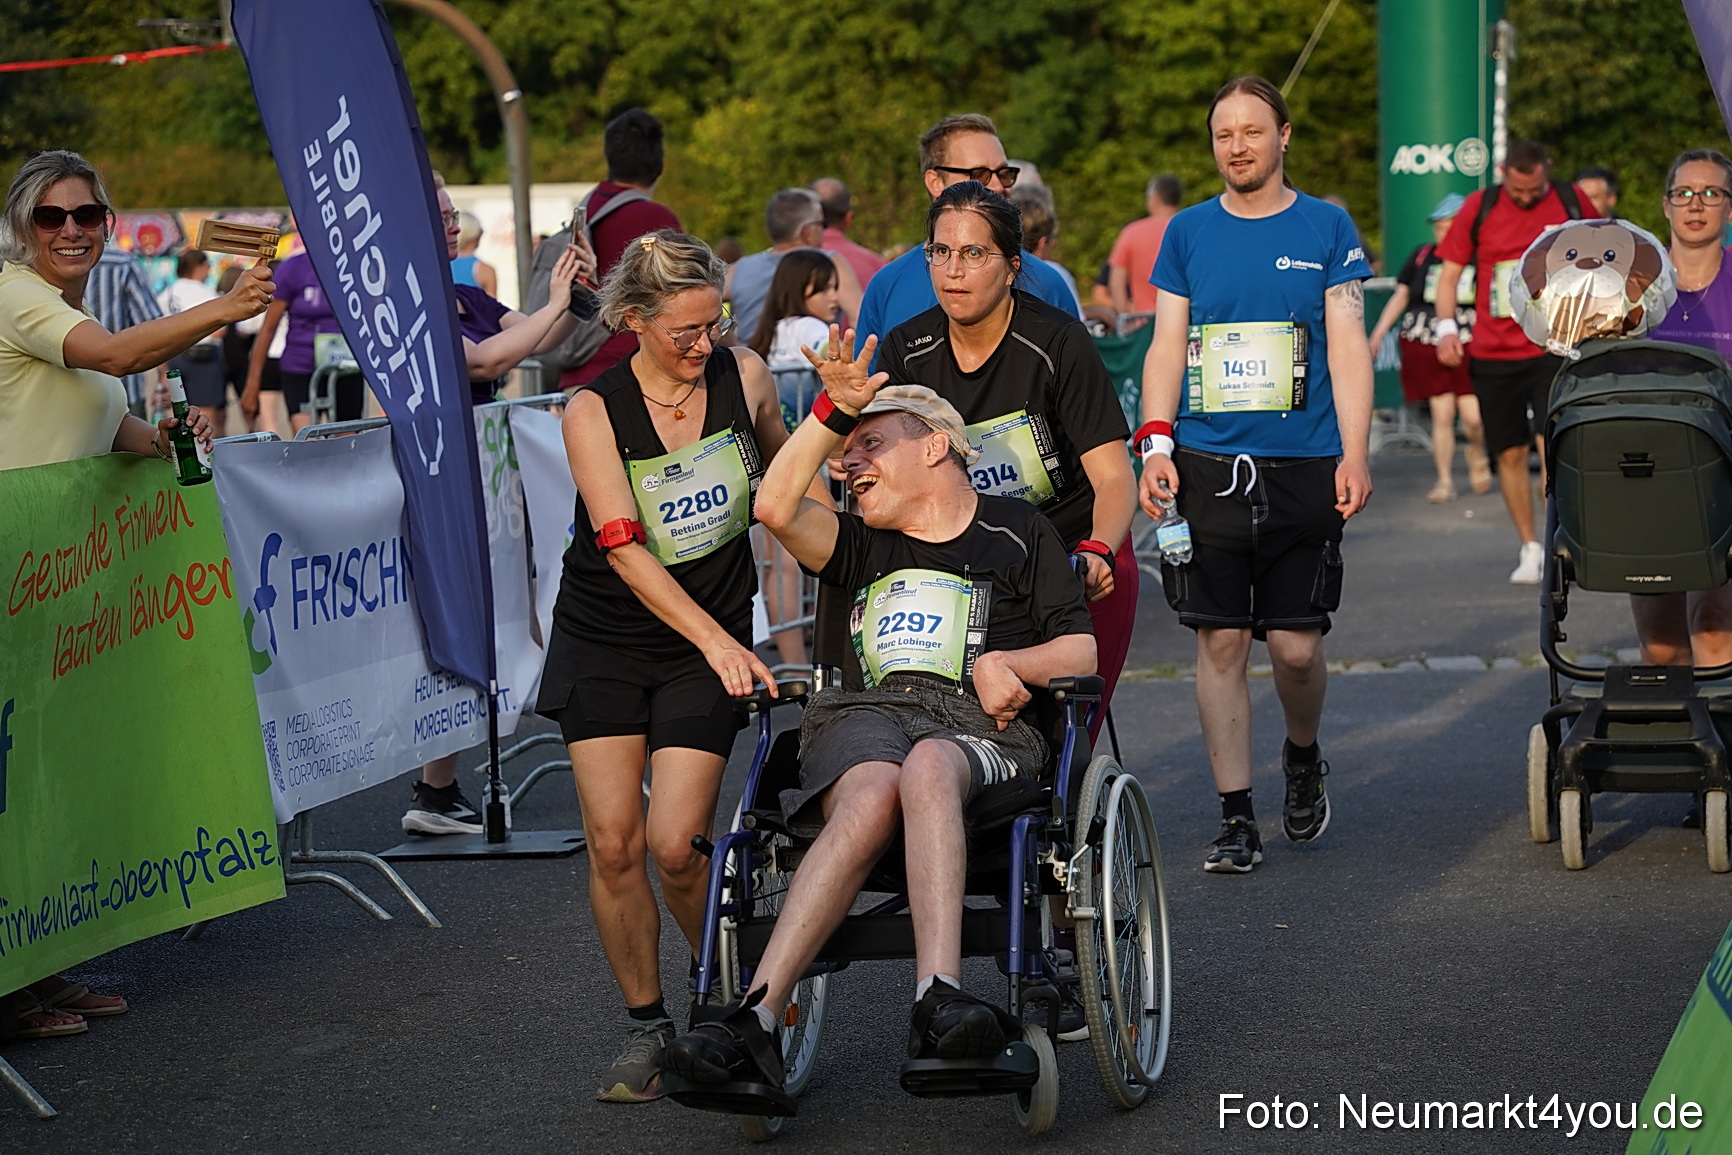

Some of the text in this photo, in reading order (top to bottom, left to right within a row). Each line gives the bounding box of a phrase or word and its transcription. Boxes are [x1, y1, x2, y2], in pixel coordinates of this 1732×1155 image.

[1390, 143, 1456, 175] AOK
[914, 335, 933, 346] JAKO
[1223, 359, 1267, 377] 1491
[1218, 382, 1241, 390] Lukas
[1294, 378, 1302, 405] HILTL
[734, 432, 747, 459] RABATT
[659, 484, 729, 525] 2280
[1000, 484, 1034, 498] Senger
[670, 509, 731, 538] Bettina Gradl
[8, 493, 195, 617] Gesunde Firmen
[969, 587, 978, 612] RABATT
[52, 557, 233, 681] laufen länger
[877, 612, 943, 638] 2297
[876, 640, 896, 652] Marc
[898, 637, 943, 649] Lobinger
[965, 646, 977, 676] HILTL
[415, 669, 443, 703] HEUTE
[414, 706, 453, 744] MORGEN
[286, 720, 361, 762] CORPORATE PRINT
[288, 741, 375, 787] CORPORATE SIGNAGE
